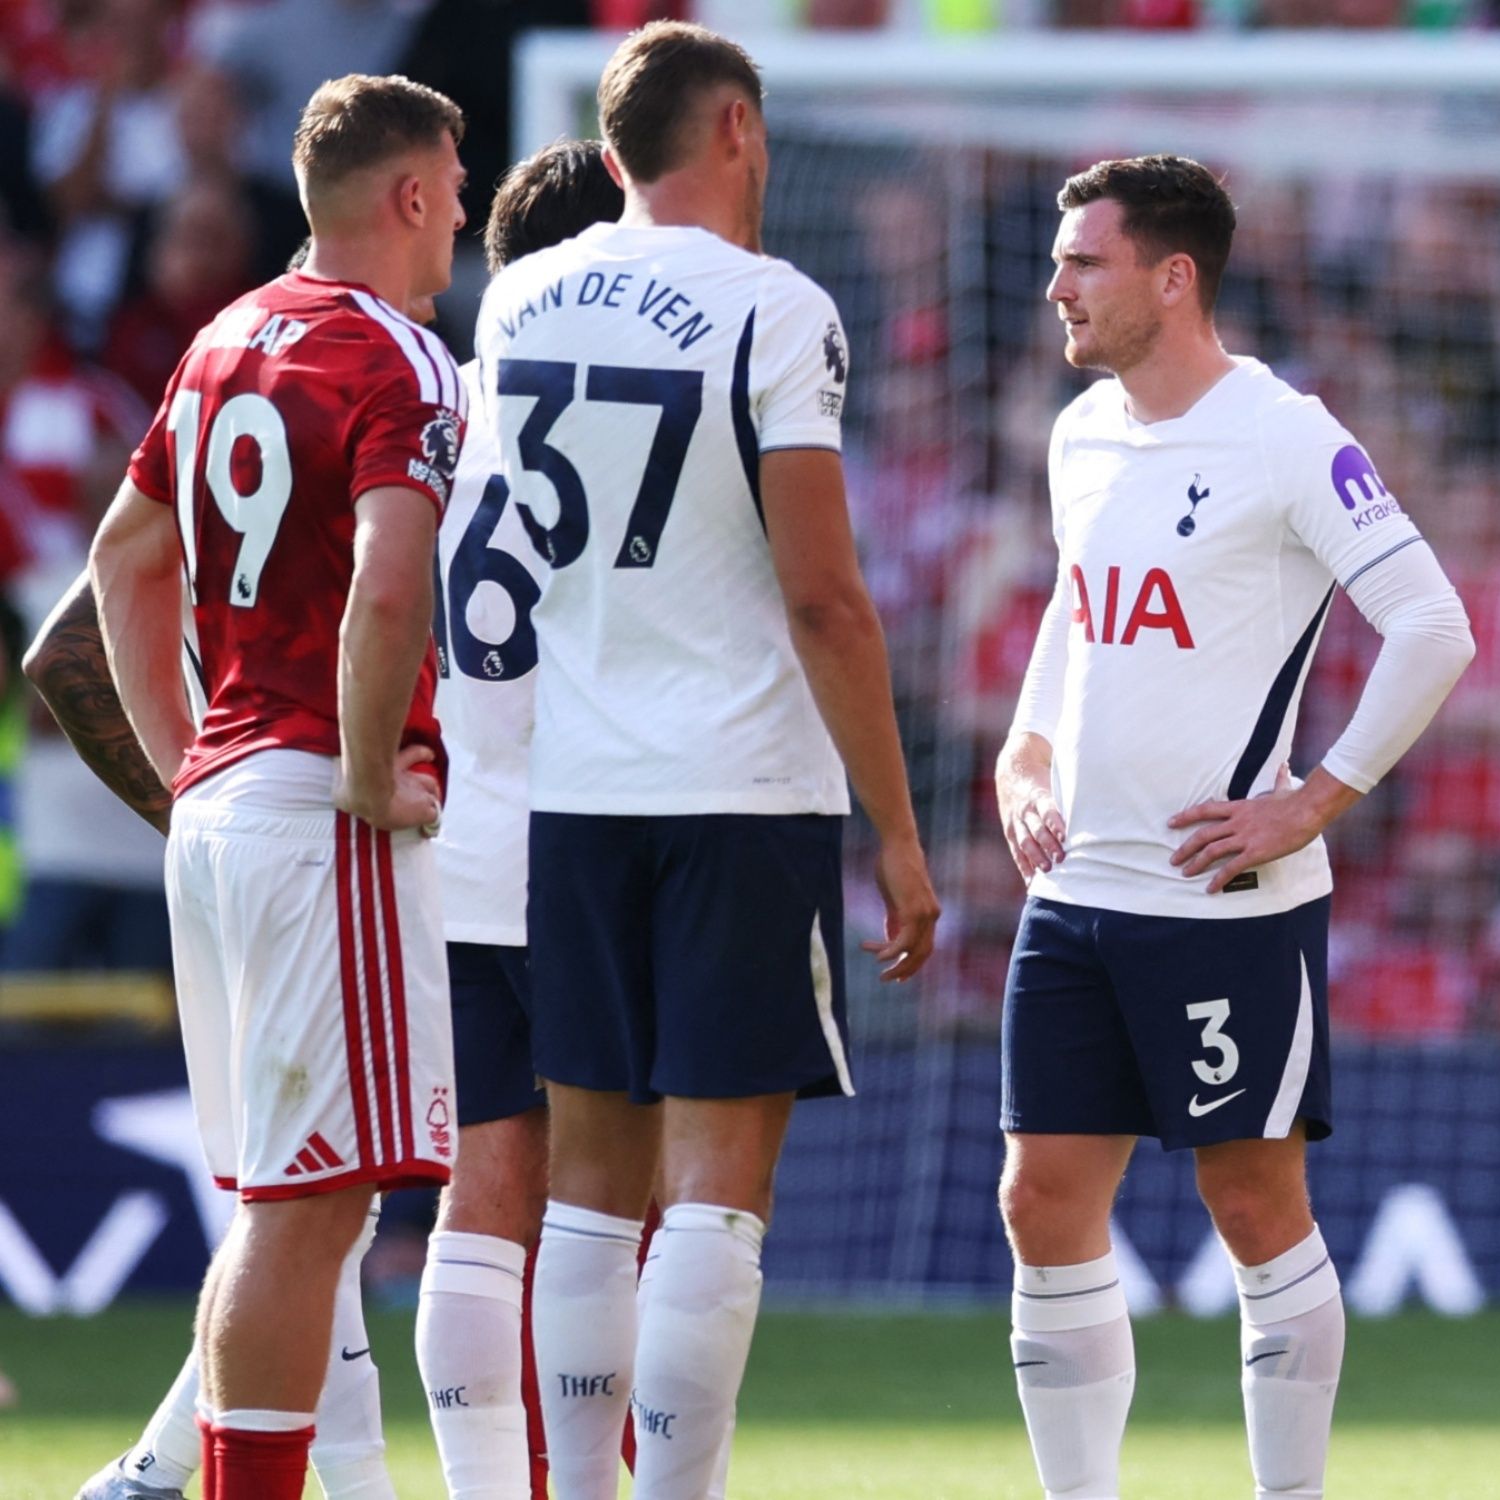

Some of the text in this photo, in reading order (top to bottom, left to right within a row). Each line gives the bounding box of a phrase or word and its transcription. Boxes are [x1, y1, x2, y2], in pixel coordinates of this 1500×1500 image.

[498, 272, 713, 352] VAN DE VEN
[166, 389, 293, 608] 19
[498, 358, 704, 570] 37
[1070, 563, 1196, 649] AIA
[1185, 998, 1240, 1085] 3
[558, 1373, 616, 1397] THFC
